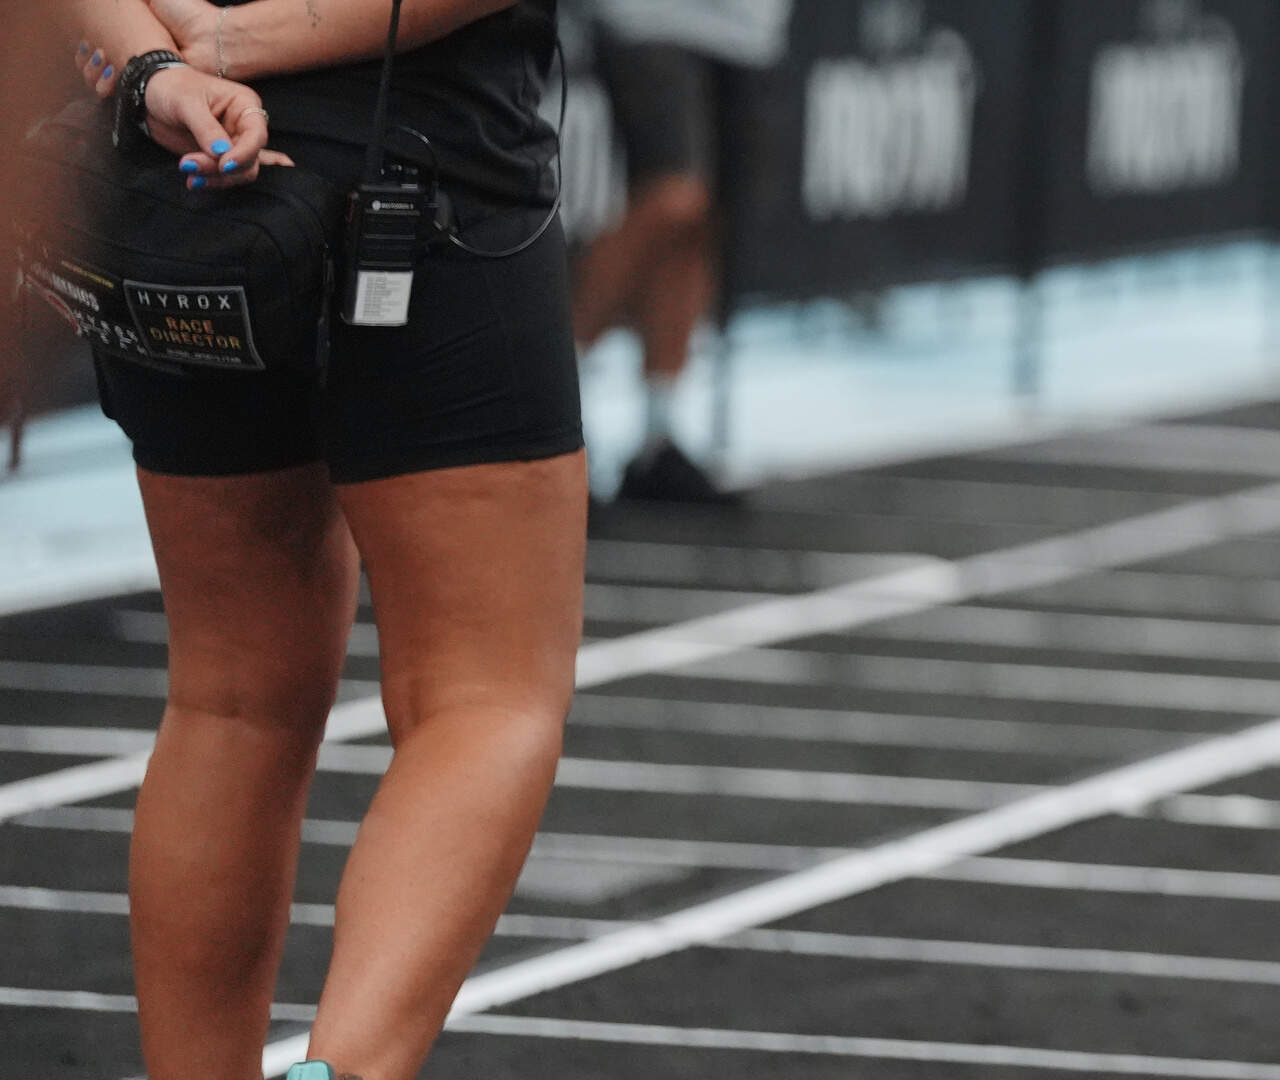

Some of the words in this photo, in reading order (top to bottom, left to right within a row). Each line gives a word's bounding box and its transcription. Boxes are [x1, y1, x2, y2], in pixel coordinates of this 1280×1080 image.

[137, 290, 231, 310] HYROX
[166, 315, 214, 334] RACE
[150, 327, 241, 350] DIRECTOR
